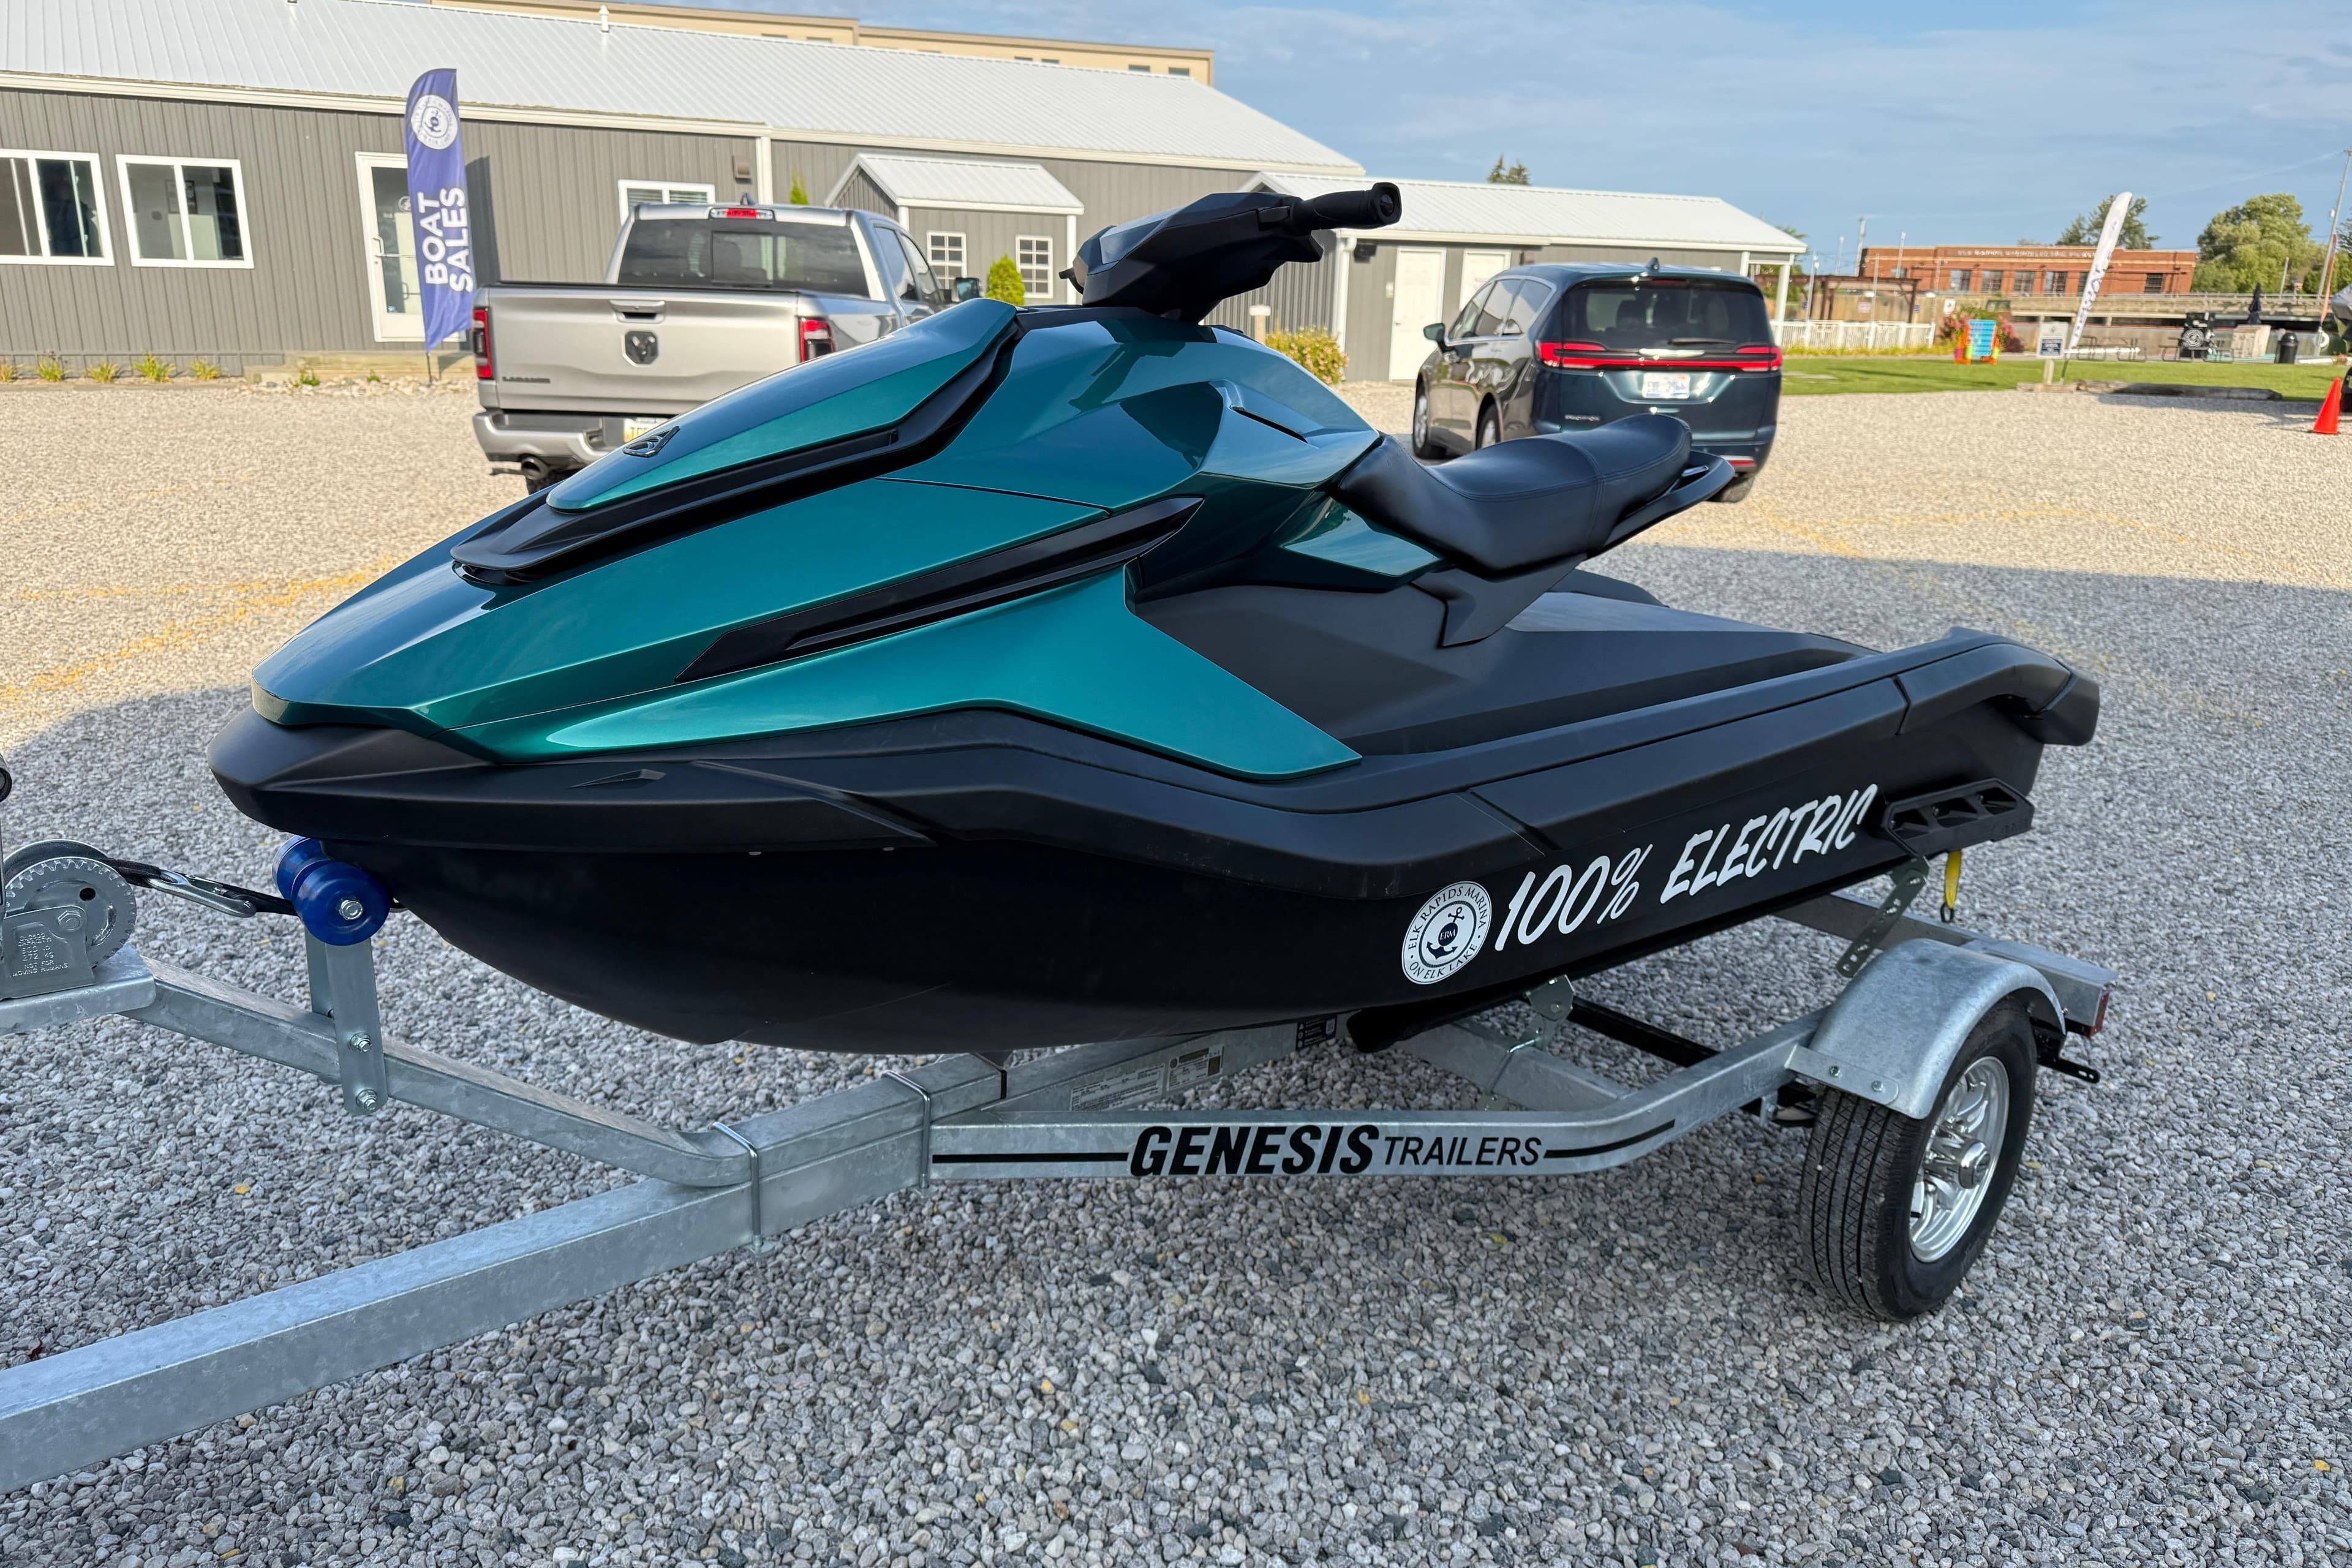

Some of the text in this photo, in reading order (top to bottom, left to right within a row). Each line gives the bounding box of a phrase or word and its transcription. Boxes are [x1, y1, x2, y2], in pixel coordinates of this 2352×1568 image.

[417, 192, 448, 284] BOAT
[440, 187, 473, 292] SALES
[1494, 783, 1879, 951] 100% ELECTRIC
[1409, 886, 1488, 950] ELK RAPIDS MARINA
[1440, 929, 1456, 940] ERM
[1409, 944, 1477, 979] ON ELK LAKE
[1130, 1125, 1542, 1177] GENESIS TRAILERS
